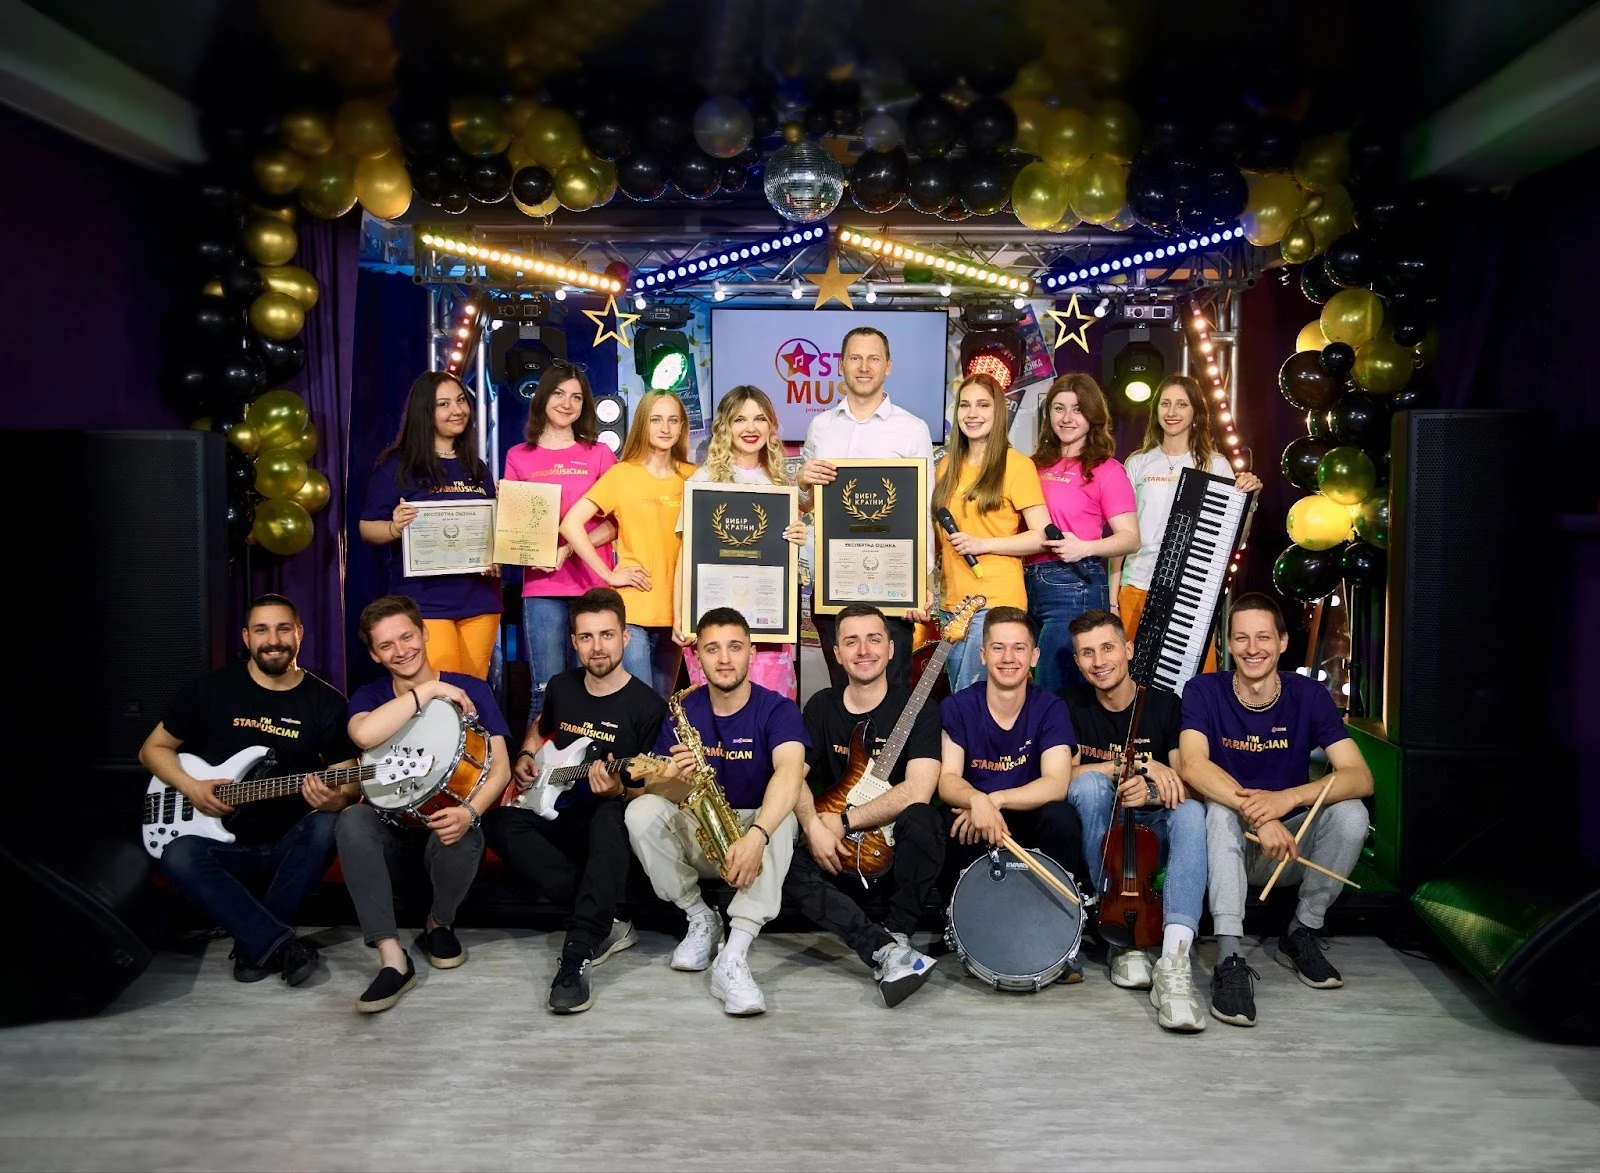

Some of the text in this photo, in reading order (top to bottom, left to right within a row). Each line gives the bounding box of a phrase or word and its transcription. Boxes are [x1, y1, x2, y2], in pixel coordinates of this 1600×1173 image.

[725, 517, 748, 525] ВИБІР
[260, 716, 273, 725] I'M
[582, 721, 594, 730] I'M
[559, 722, 616, 743] STARMUSICIAN
[1246, 735, 1260, 744] I'M
[1109, 742, 1122, 753] I'M
[999, 755, 1012, 763] I'M
